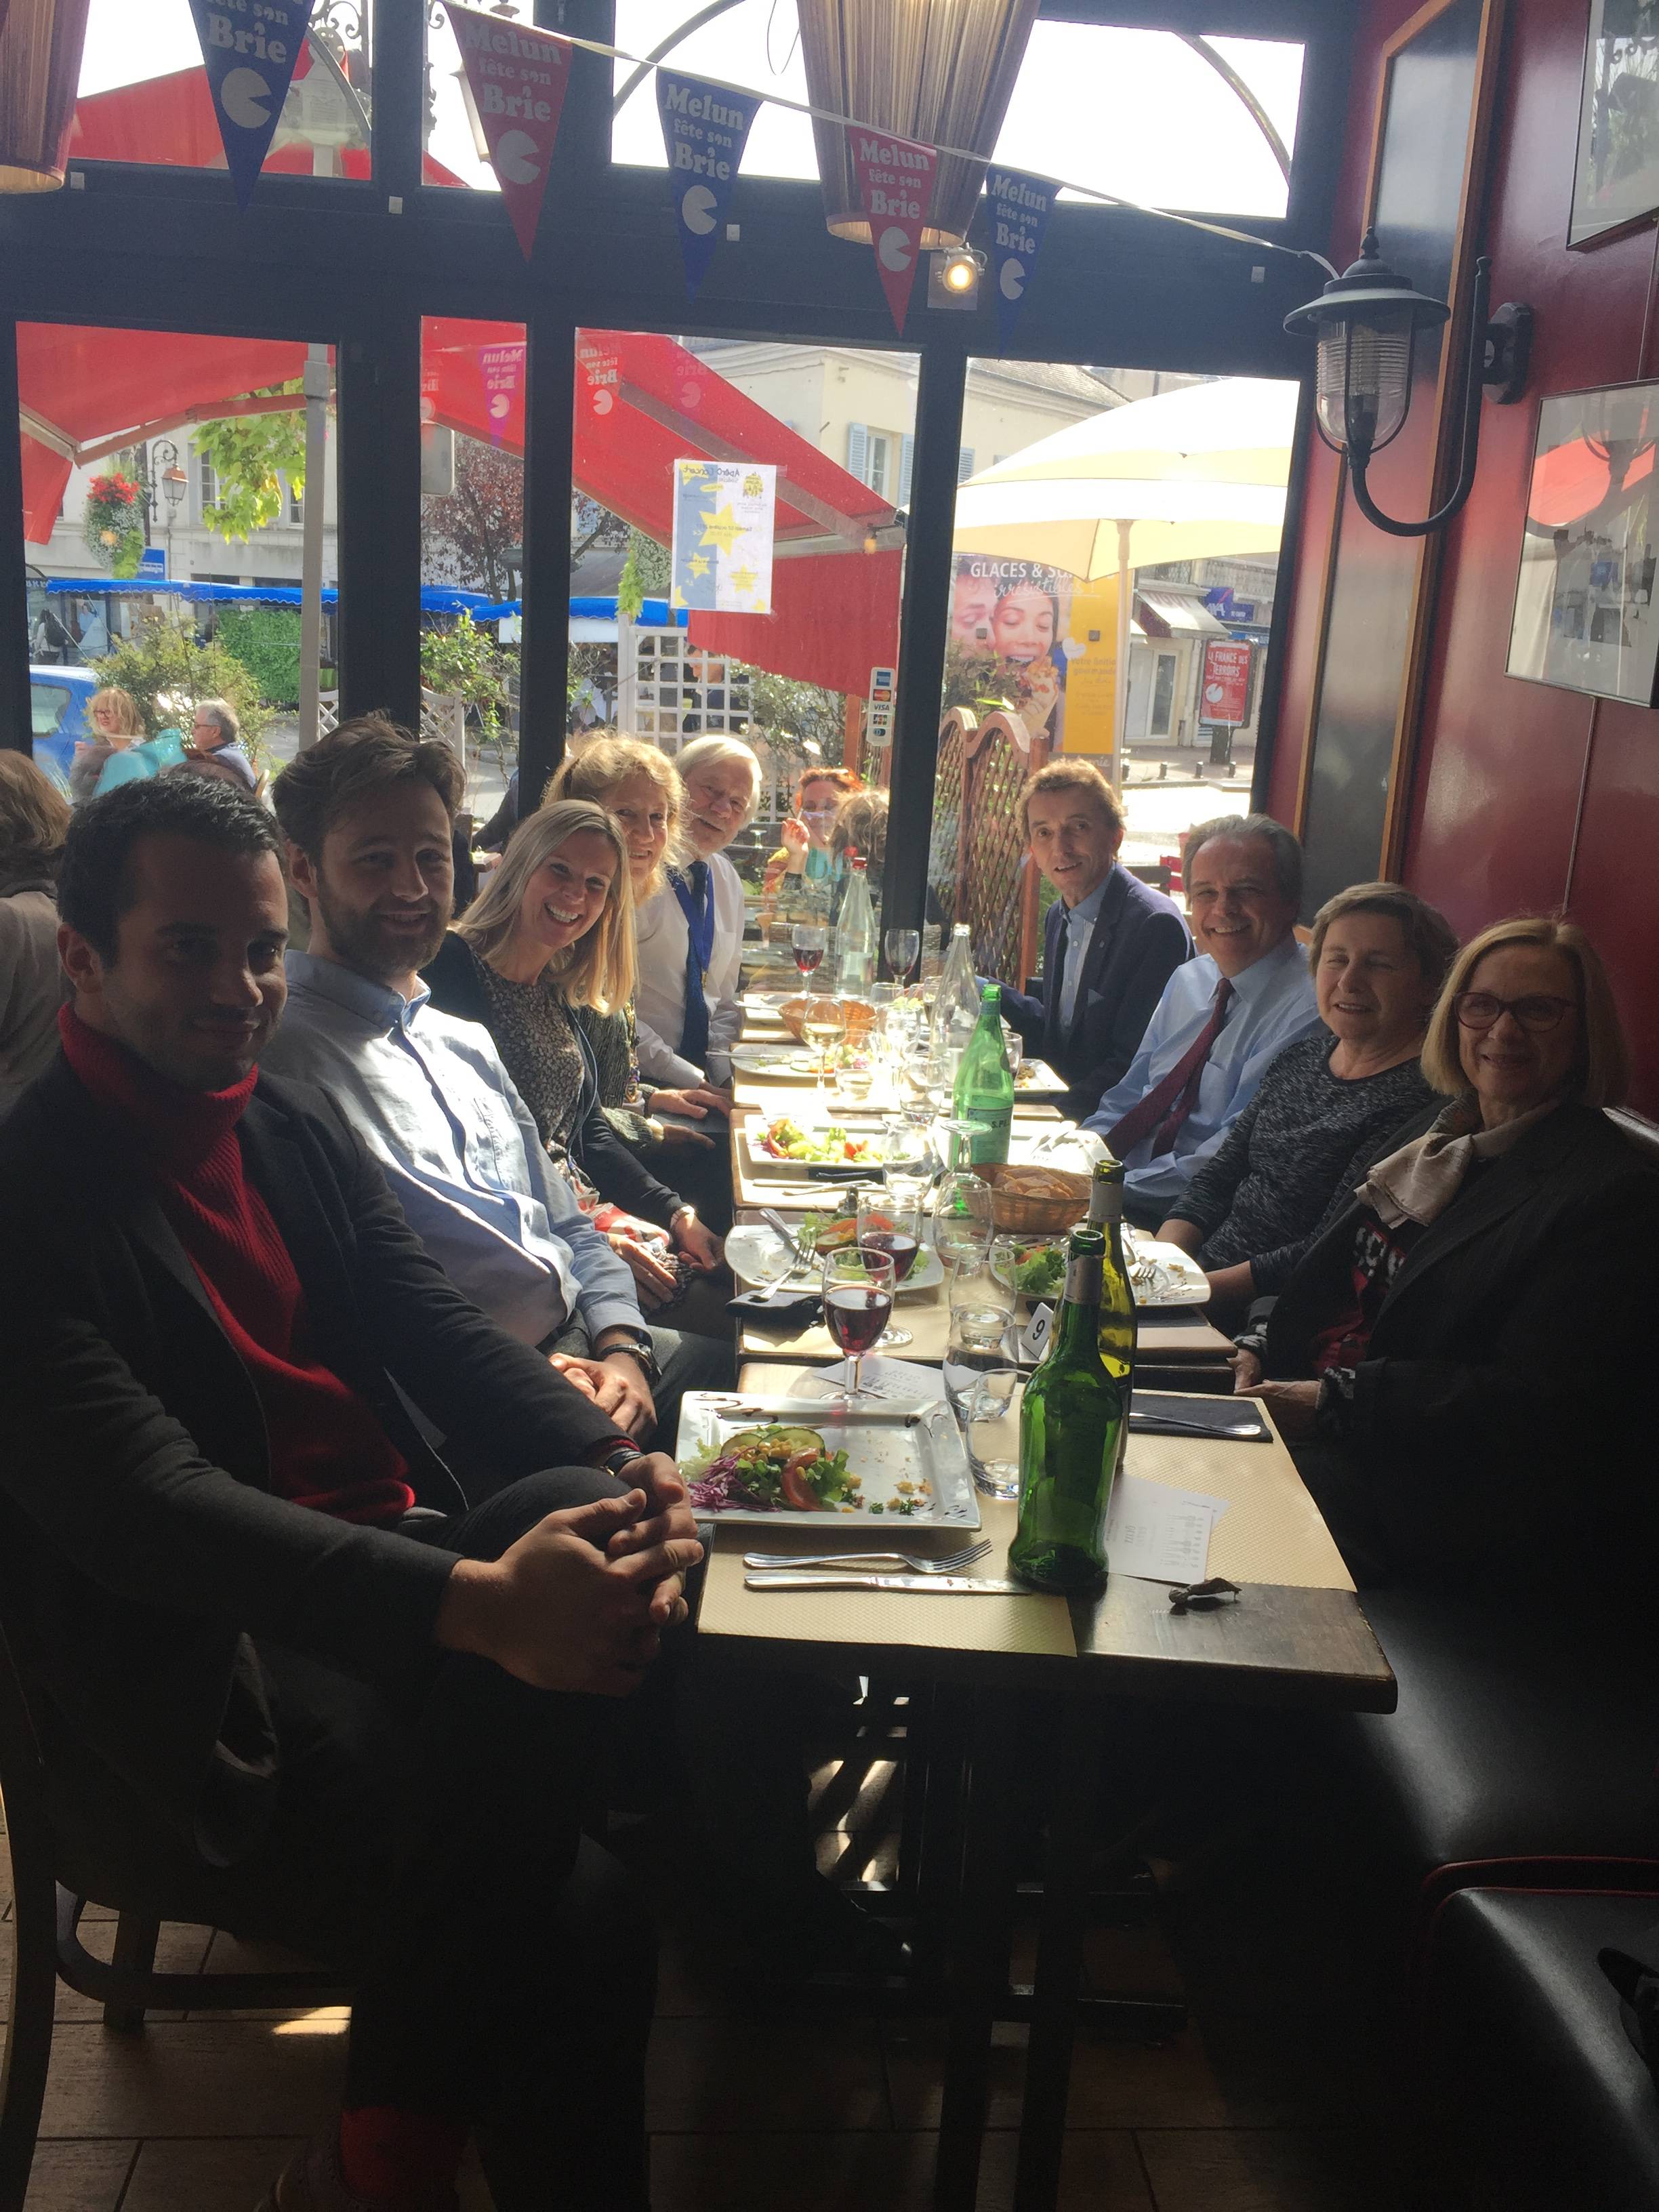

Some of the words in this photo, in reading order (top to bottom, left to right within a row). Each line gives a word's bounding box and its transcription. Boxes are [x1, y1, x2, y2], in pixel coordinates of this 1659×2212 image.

[253, 3, 288, 25] son
[206, 12, 287, 64] Brie
[465, 19, 562, 65] Melun
[478, 56, 515, 79] fête
[520, 68, 551, 85] son
[482, 82, 551, 122] Brie
[664, 83, 743, 131] Melun
[674, 118, 703, 140] fête
[707, 131, 732, 148] son
[674, 141, 731, 180] Brie
[859, 138, 930, 171] Melun
[868, 168, 895, 184] fête
[899, 176, 921, 188] son
[991, 174, 1046, 212] Melun
[870, 189, 920, 220] Brie
[996, 203, 1018, 220] fête
[1019, 213, 1038, 227] son
[996, 222, 1036, 254] Brie
[970, 562, 1026, 577] GLACES
[1031, 563, 1042, 577] &
[1215, 651, 1237, 663] FRANCE
[1032, 1319, 1046, 1340] 9
